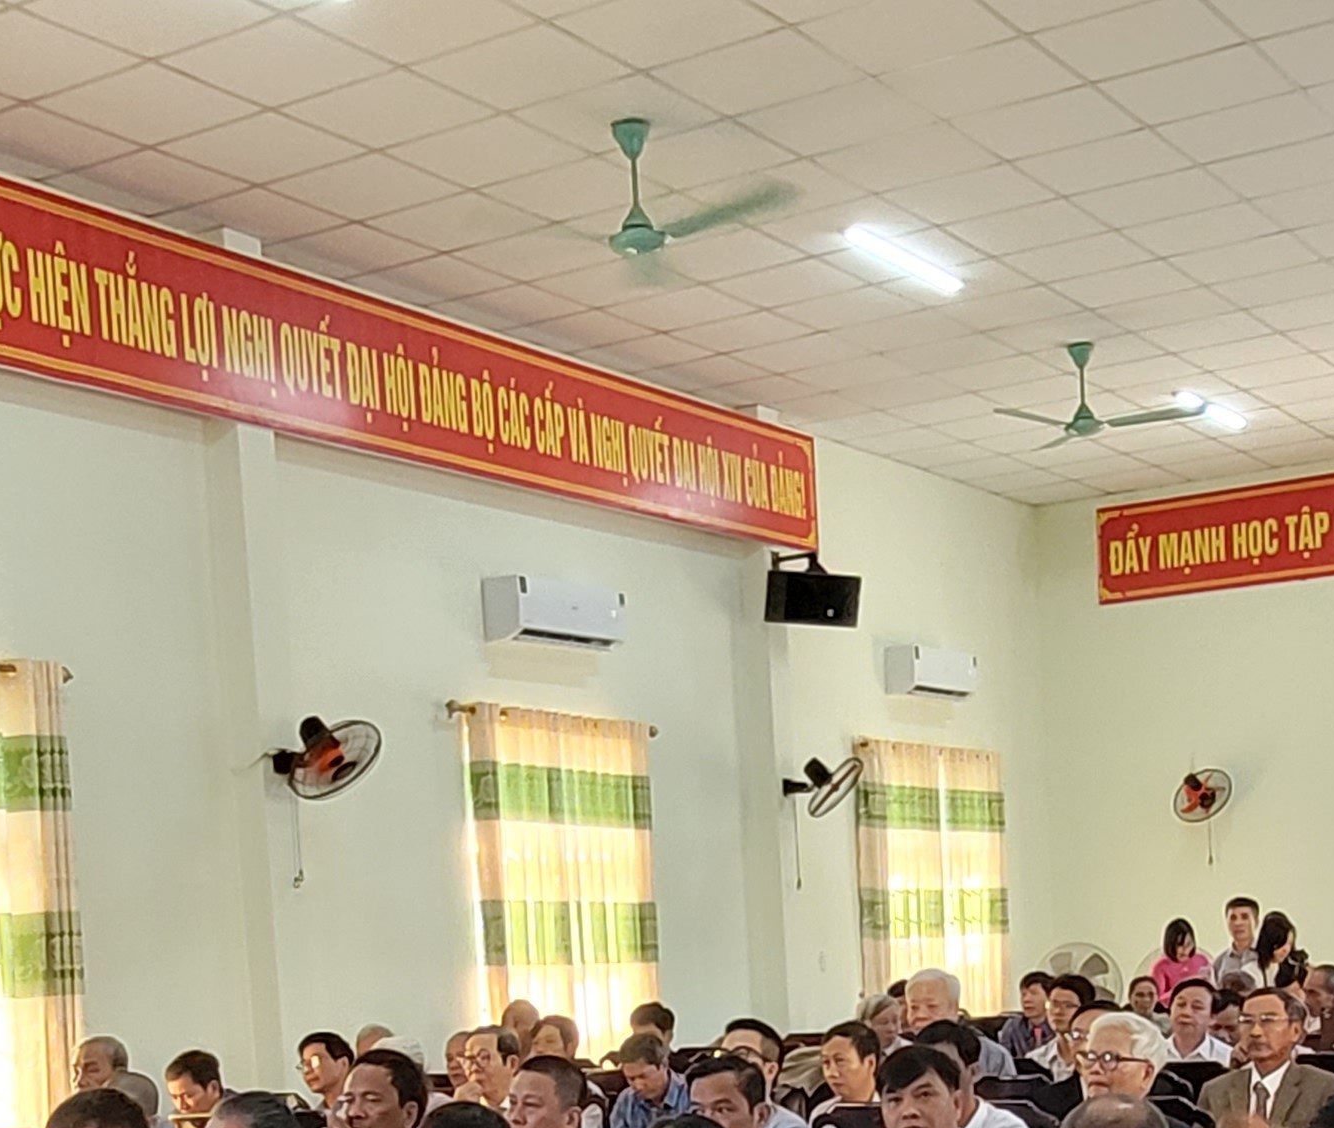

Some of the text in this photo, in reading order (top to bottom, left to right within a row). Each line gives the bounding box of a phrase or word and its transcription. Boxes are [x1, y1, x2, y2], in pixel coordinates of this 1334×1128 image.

[27, 240, 92, 348] HIỆN
[94, 251, 177, 359] THẮNG
[180, 292, 218, 382] LỢI
[221, 305, 277, 398] NGHỊ
[279, 314, 342, 400] QUYẾT
[346, 341, 380, 423] ĐẠI
[383, 343, 416, 432] HỘI
[419, 346, 469, 434] ĐẢNG
[470, 370, 494, 454] BỘ
[498, 377, 531, 450] CÁC
[534, 381, 565, 458] CẤP
[567, 397, 590, 465] VÀ
[590, 412, 628, 487] NGHỊ
[629, 415, 670, 486] QUYẾT
[697, 435, 721, 508] HỘI
[721, 450, 742, 503] XIV
[744, 443, 770, 511] CỦA
[1109, 523, 1152, 576] ĐẨY
[1158, 525, 1226, 575] MẠNH
[1232, 518, 1279, 565] HỌC
[1285, 505, 1330, 559] TẬP
